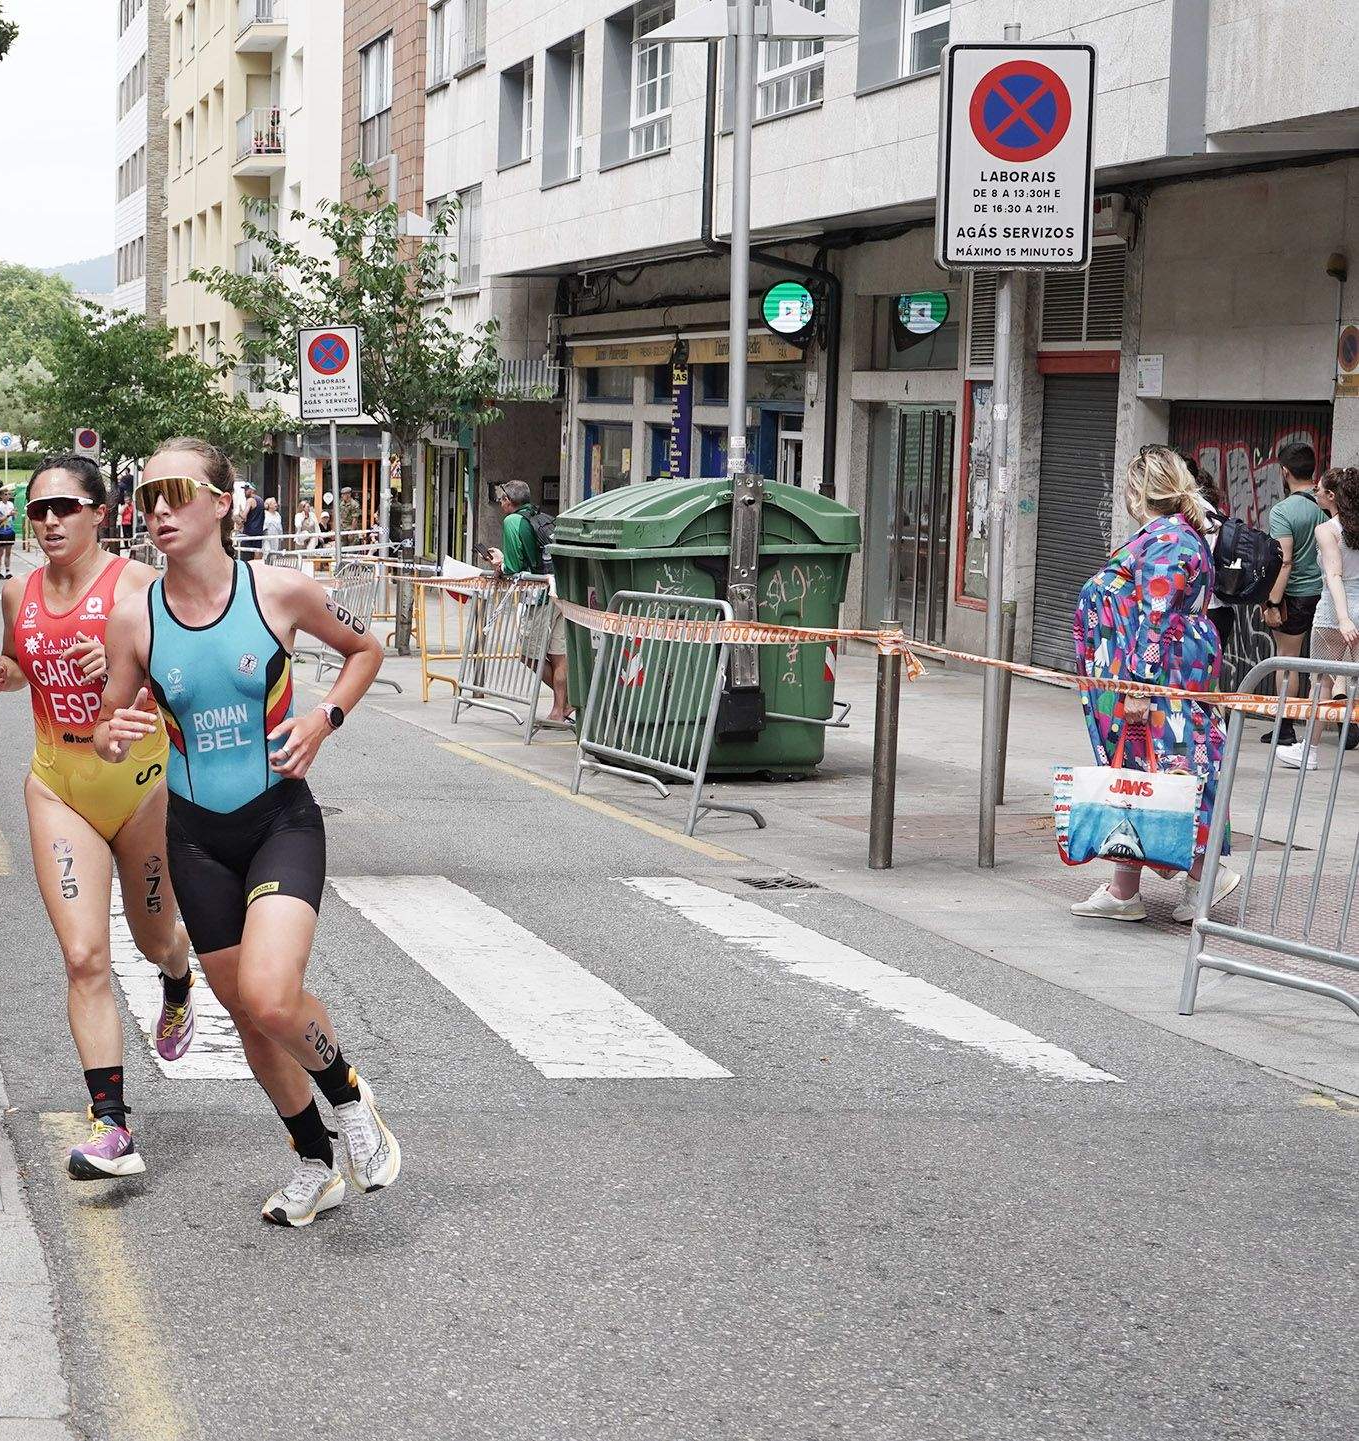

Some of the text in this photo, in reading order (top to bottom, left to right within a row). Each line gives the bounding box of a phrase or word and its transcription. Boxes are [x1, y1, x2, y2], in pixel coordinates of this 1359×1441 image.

[980, 171, 1056, 183] LABORAIS
[973, 188, 1061, 198] DE 8 A 13:30H E
[973, 204, 988, 213] DE
[992, 204, 1021, 213] 16:30
[1025, 204, 1033, 213] A
[956, 223, 1075, 239] AGÁS SERVIZOS
[955, 245, 1074, 257] MÁXIMO 15 MINUTOS
[42, 639, 55, 649] LA
[31, 656, 97, 688] GARC
[50, 691, 102, 725] ESP
[192, 703, 249, 732] ROMAN
[75, 734, 94, 744] Iberd
[196, 726, 252, 753] BEL
[1109, 778, 1155, 797] JAWS
[57, 857, 80, 900] 75
